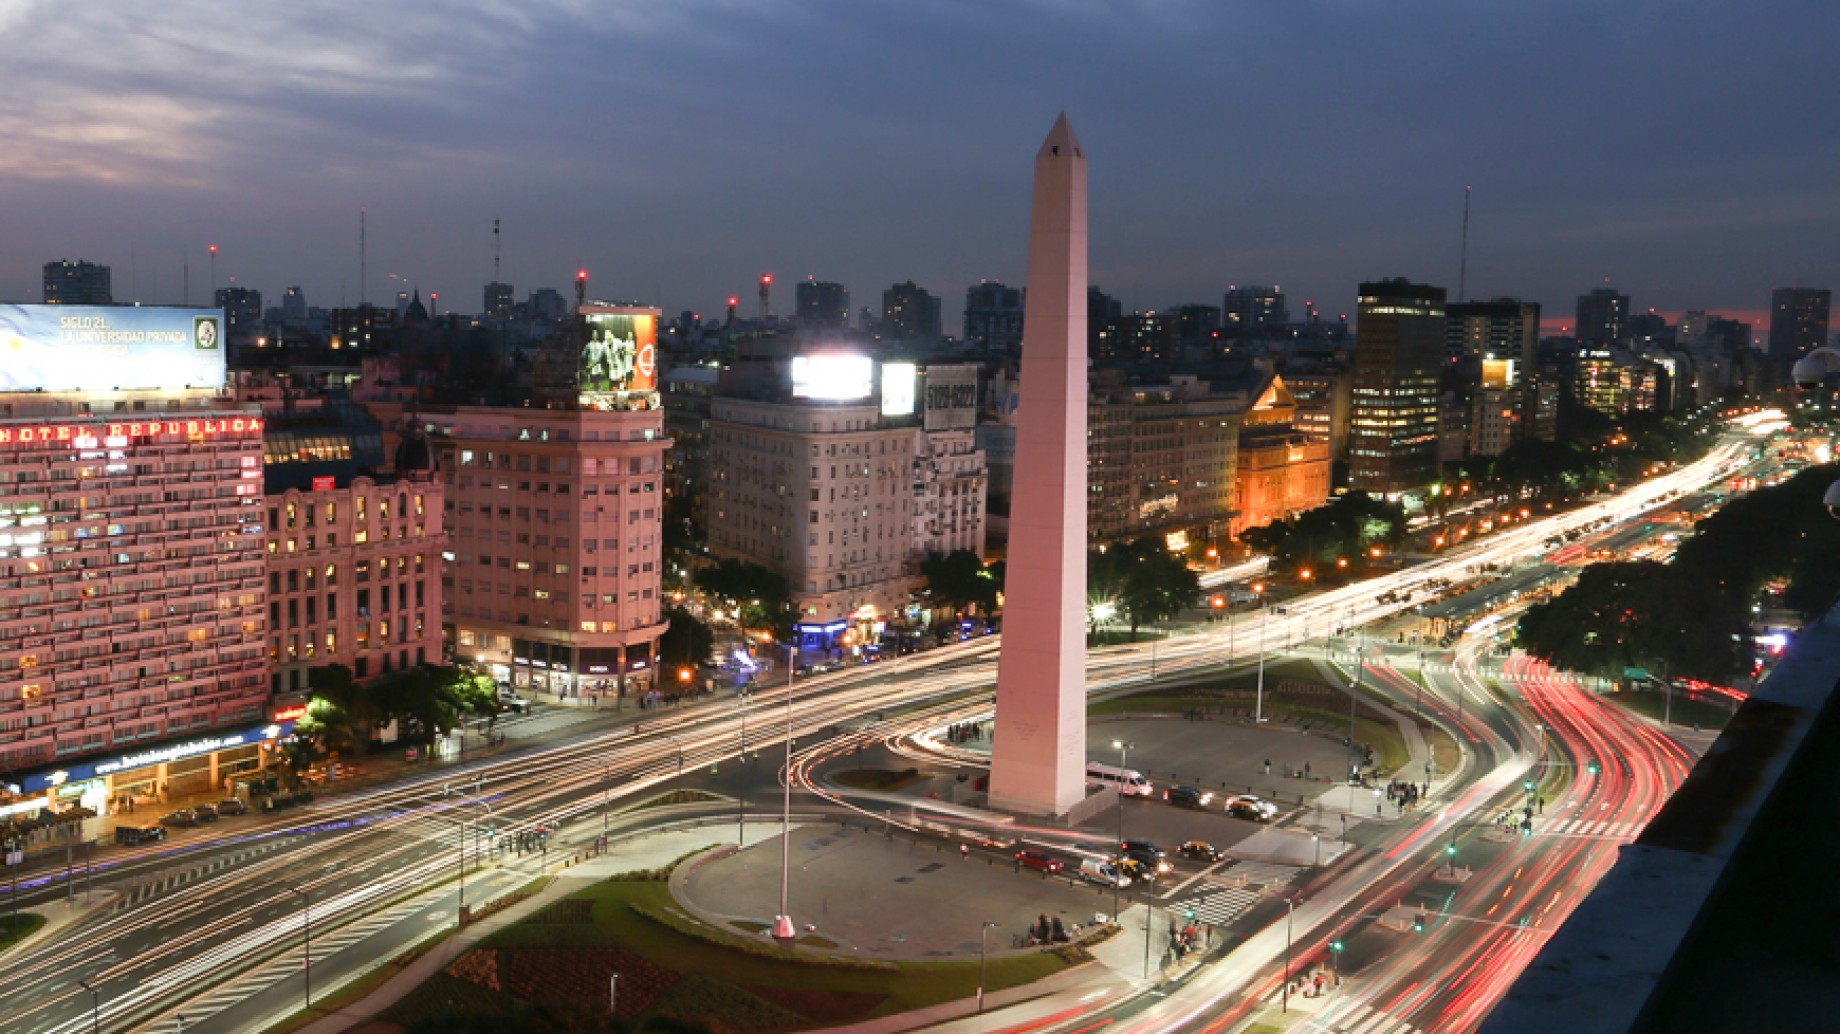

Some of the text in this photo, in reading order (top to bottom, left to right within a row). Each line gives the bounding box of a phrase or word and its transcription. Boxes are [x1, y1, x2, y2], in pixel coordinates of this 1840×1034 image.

[61, 317, 91, 329] SIGLO
[61, 332, 187, 344] LA UNIVERSIDAD PRIVADA
[0, 419, 260, 443] HOTEL REPUBLICA
